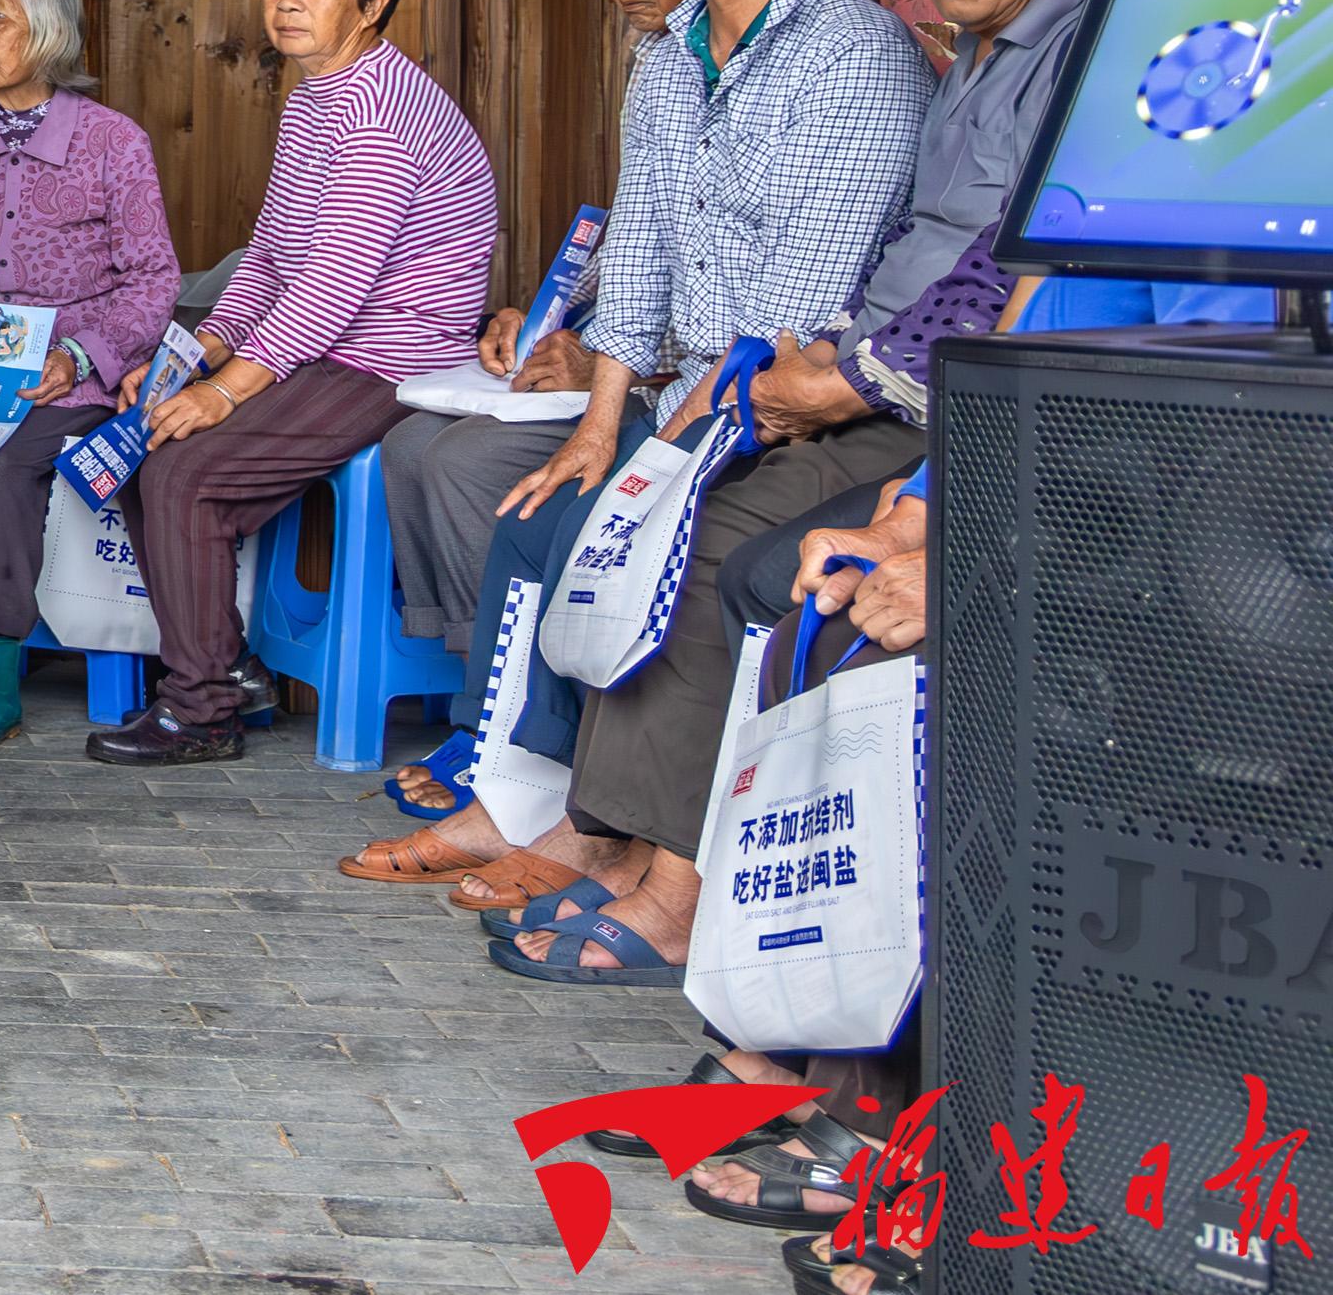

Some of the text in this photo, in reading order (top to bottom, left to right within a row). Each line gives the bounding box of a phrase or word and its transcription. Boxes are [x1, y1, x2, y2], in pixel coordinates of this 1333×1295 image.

[95, 538, 136, 566] 吃好
[738, 788, 855, 855] 不添加抗结剂
[733, 844, 858, 905] 吃好盐选闽盐
[1195, 1221, 1270, 1266] JBA
